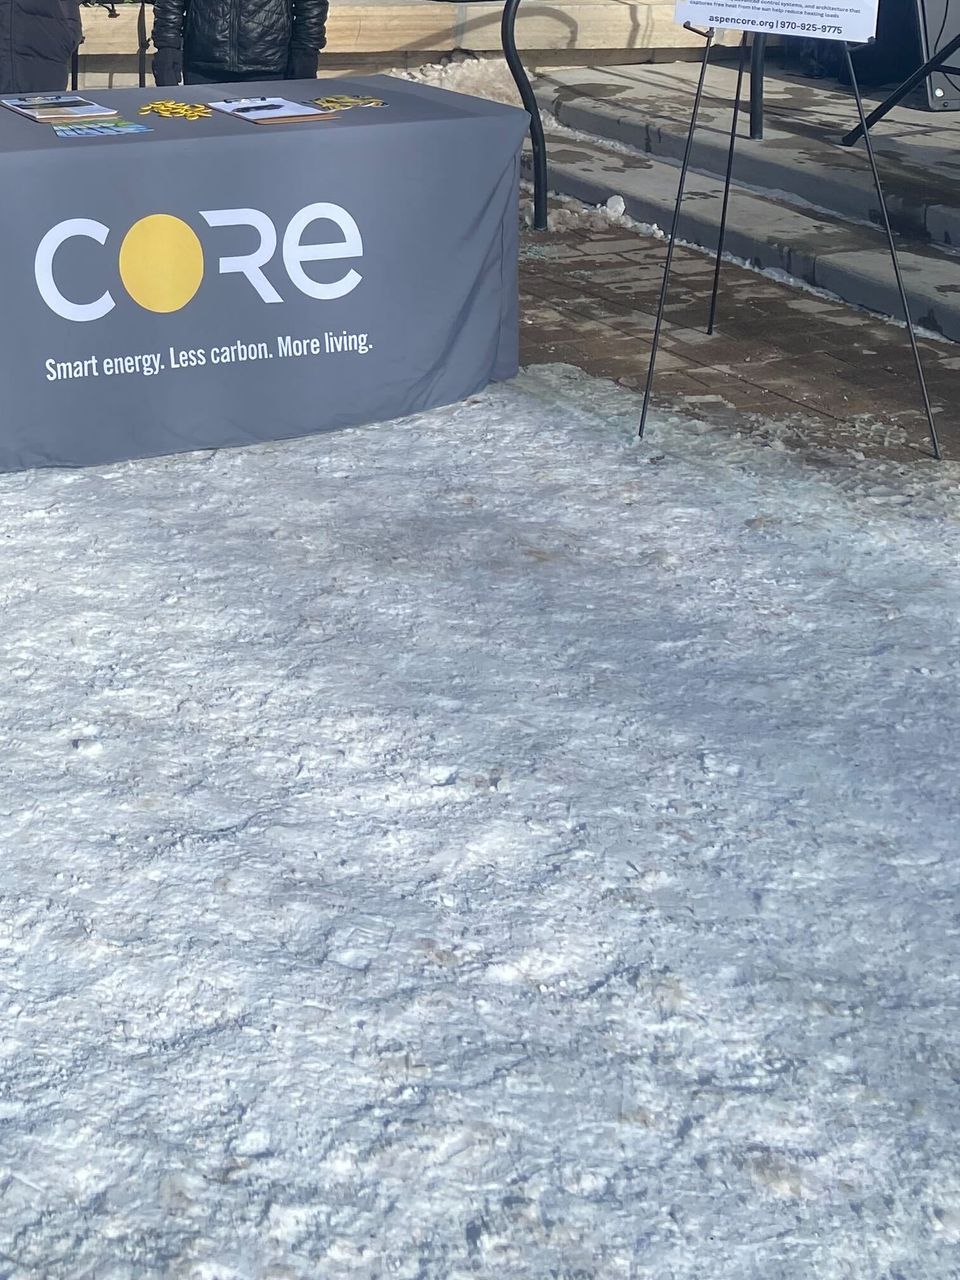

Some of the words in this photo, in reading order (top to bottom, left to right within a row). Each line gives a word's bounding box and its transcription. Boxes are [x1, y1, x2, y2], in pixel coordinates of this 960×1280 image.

[709, 17, 774, 29] aspencore.org
[780, 21, 842, 34] 970-925-9775
[45, 356, 99, 381] Smart
[103, 352, 165, 375] energy.
[170, 346, 207, 369] Less
[211, 340, 273, 364] carbon.
[277, 335, 321, 358] More
[324, 330, 373, 356] living.
